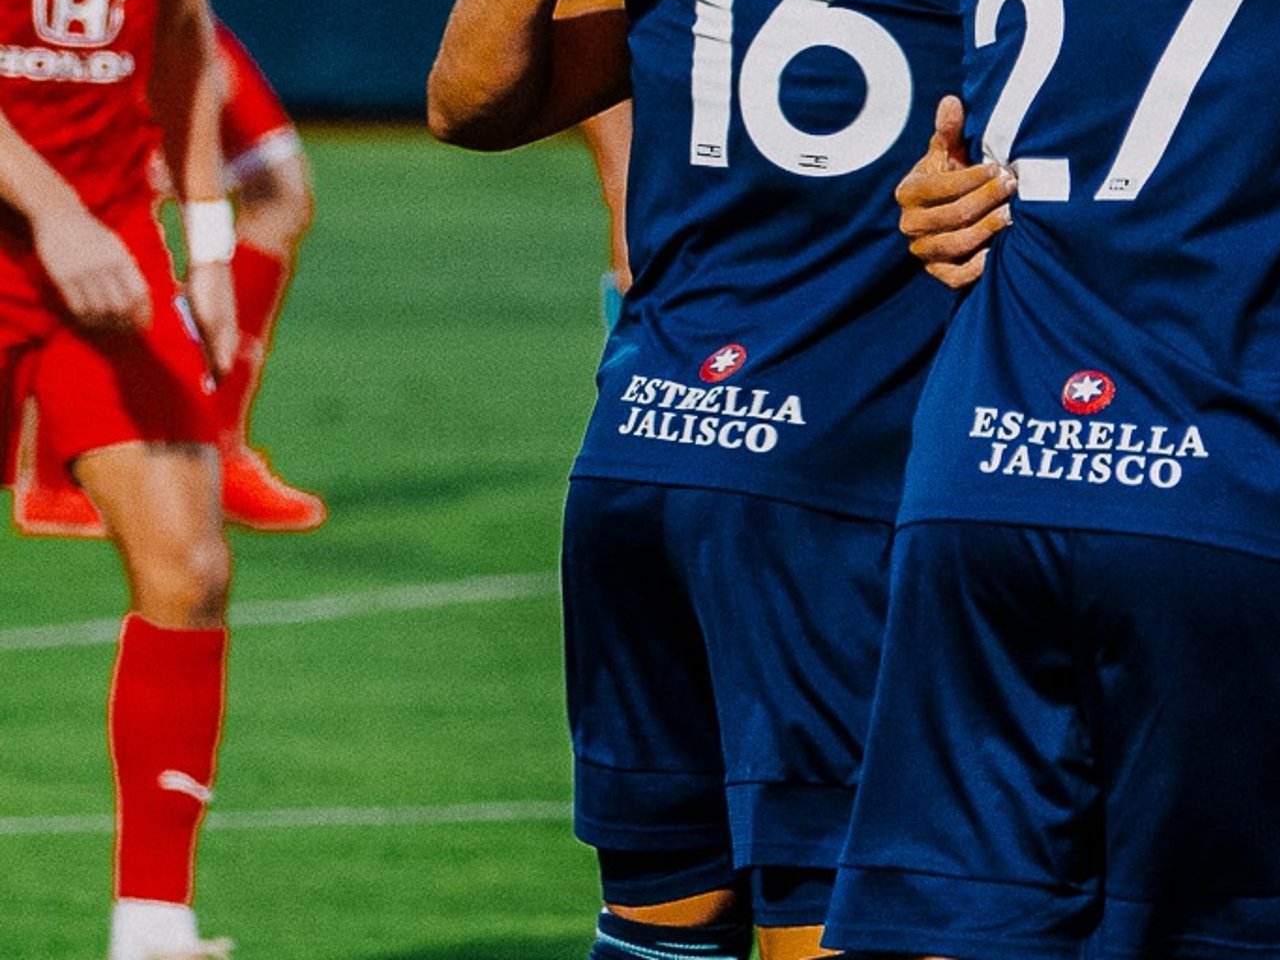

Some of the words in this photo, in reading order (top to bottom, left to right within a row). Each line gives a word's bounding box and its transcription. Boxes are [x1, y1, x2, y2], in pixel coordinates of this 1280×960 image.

[619, 374, 806, 425] ESTRELLA
[617, 407, 778, 453] JALISCO
[969, 406, 1209, 458] ESTRELLA
[979, 442, 1183, 489] JALISCO
